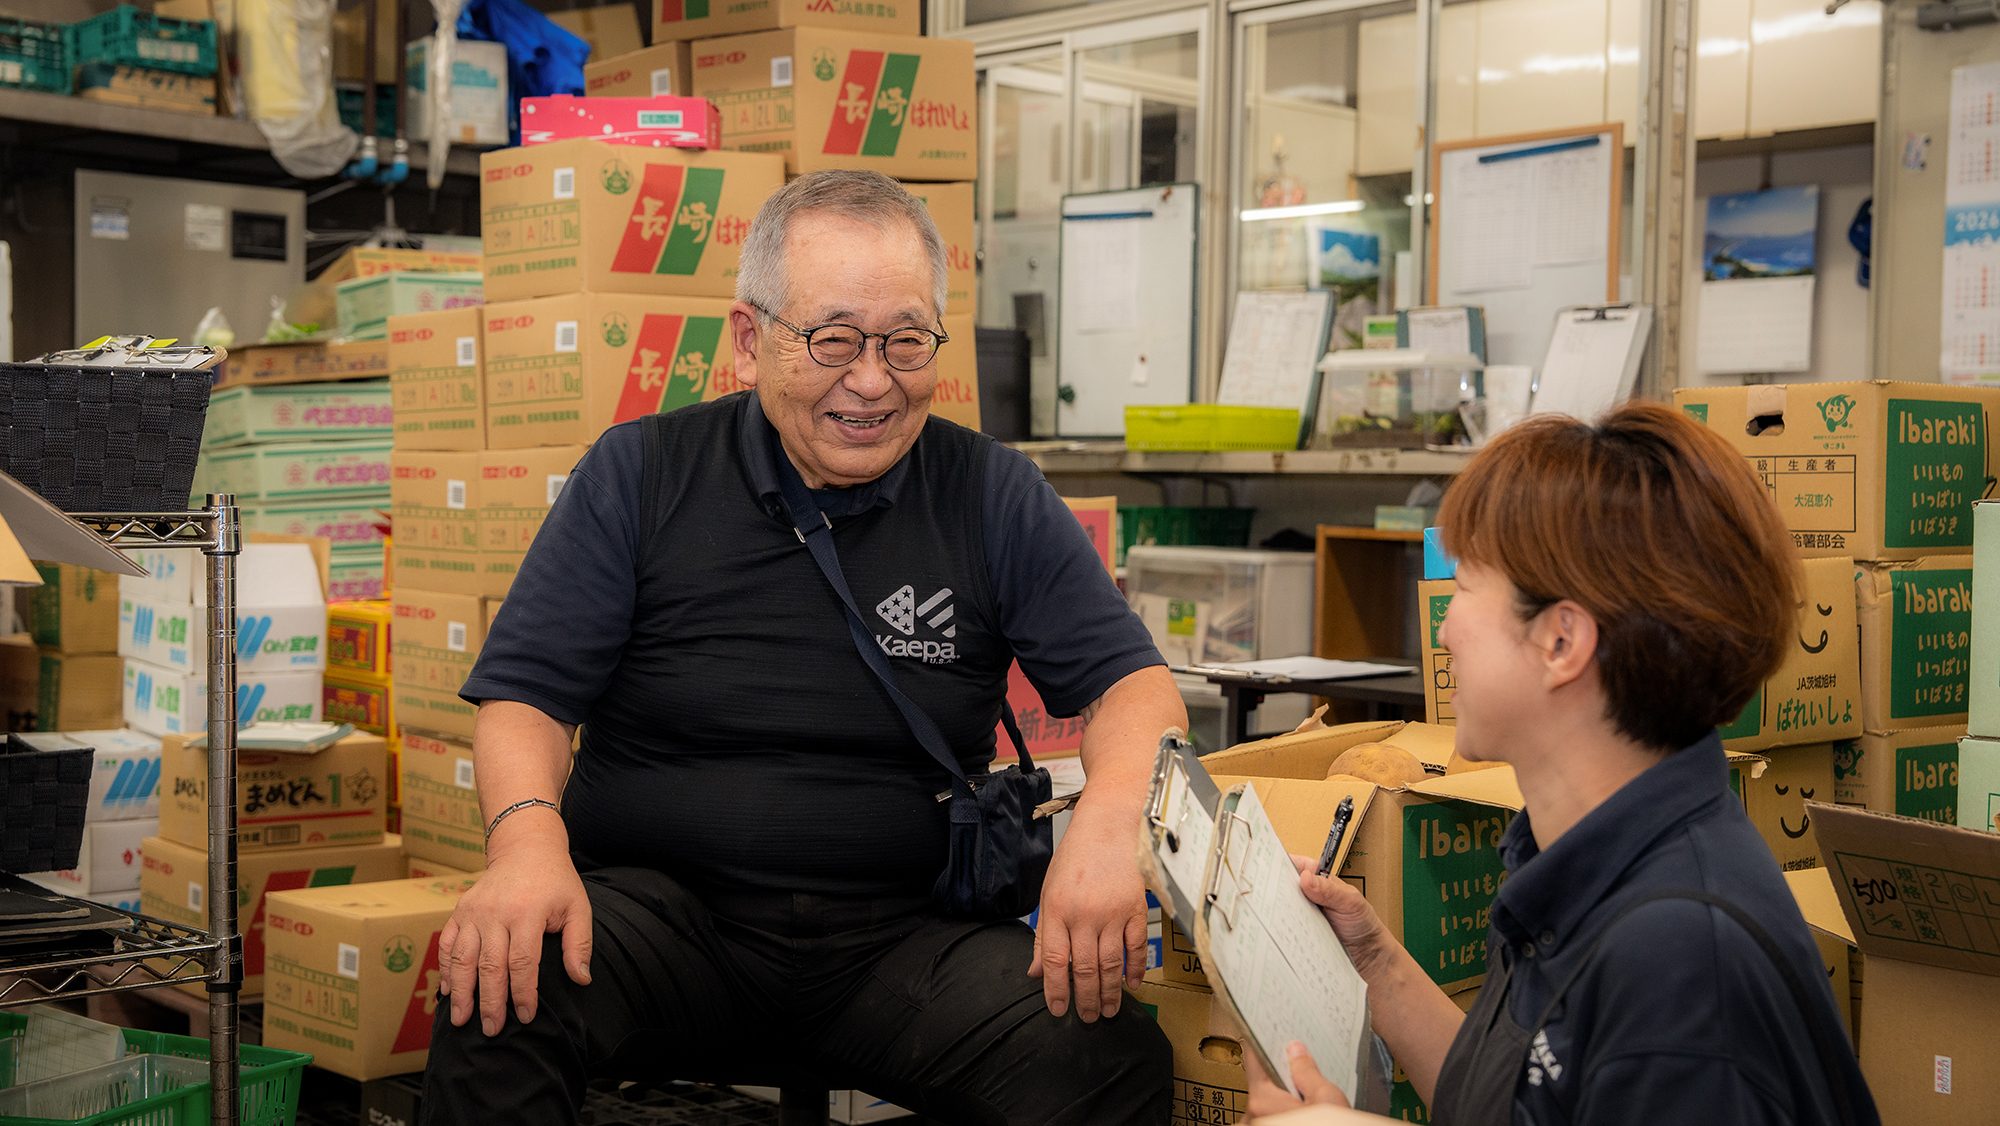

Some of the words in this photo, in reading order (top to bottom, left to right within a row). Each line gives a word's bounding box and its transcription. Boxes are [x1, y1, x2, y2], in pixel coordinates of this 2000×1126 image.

[838, 82, 907, 127] 長崎
[910, 100, 970, 131] ばれいしょ
[631, 196, 713, 244] 長崎
[1954, 211, 2000, 232] 2026
[630, 347, 709, 393] 長崎
[1899, 410, 1977, 446] Ibaraki
[1788, 459, 1837, 472] 生産者
[1913, 464, 1964, 482] いいもの
[1912, 489, 1962, 508] いっぱい
[1910, 516, 1959, 536] いばらき
[1918, 631, 1969, 651] いいもの
[1917, 657, 1967, 678] いっぱい
[1915, 683, 1965, 705] いばらき
[1905, 759, 1958, 792] Ibara
[1852, 876, 1898, 906] 500
[1182, 955, 1206, 976] JA
[304, 988, 313, 1007] A
[1189, 1104, 1208, 1122] 3L
[1212, 1109, 1232, 1126] 2L
